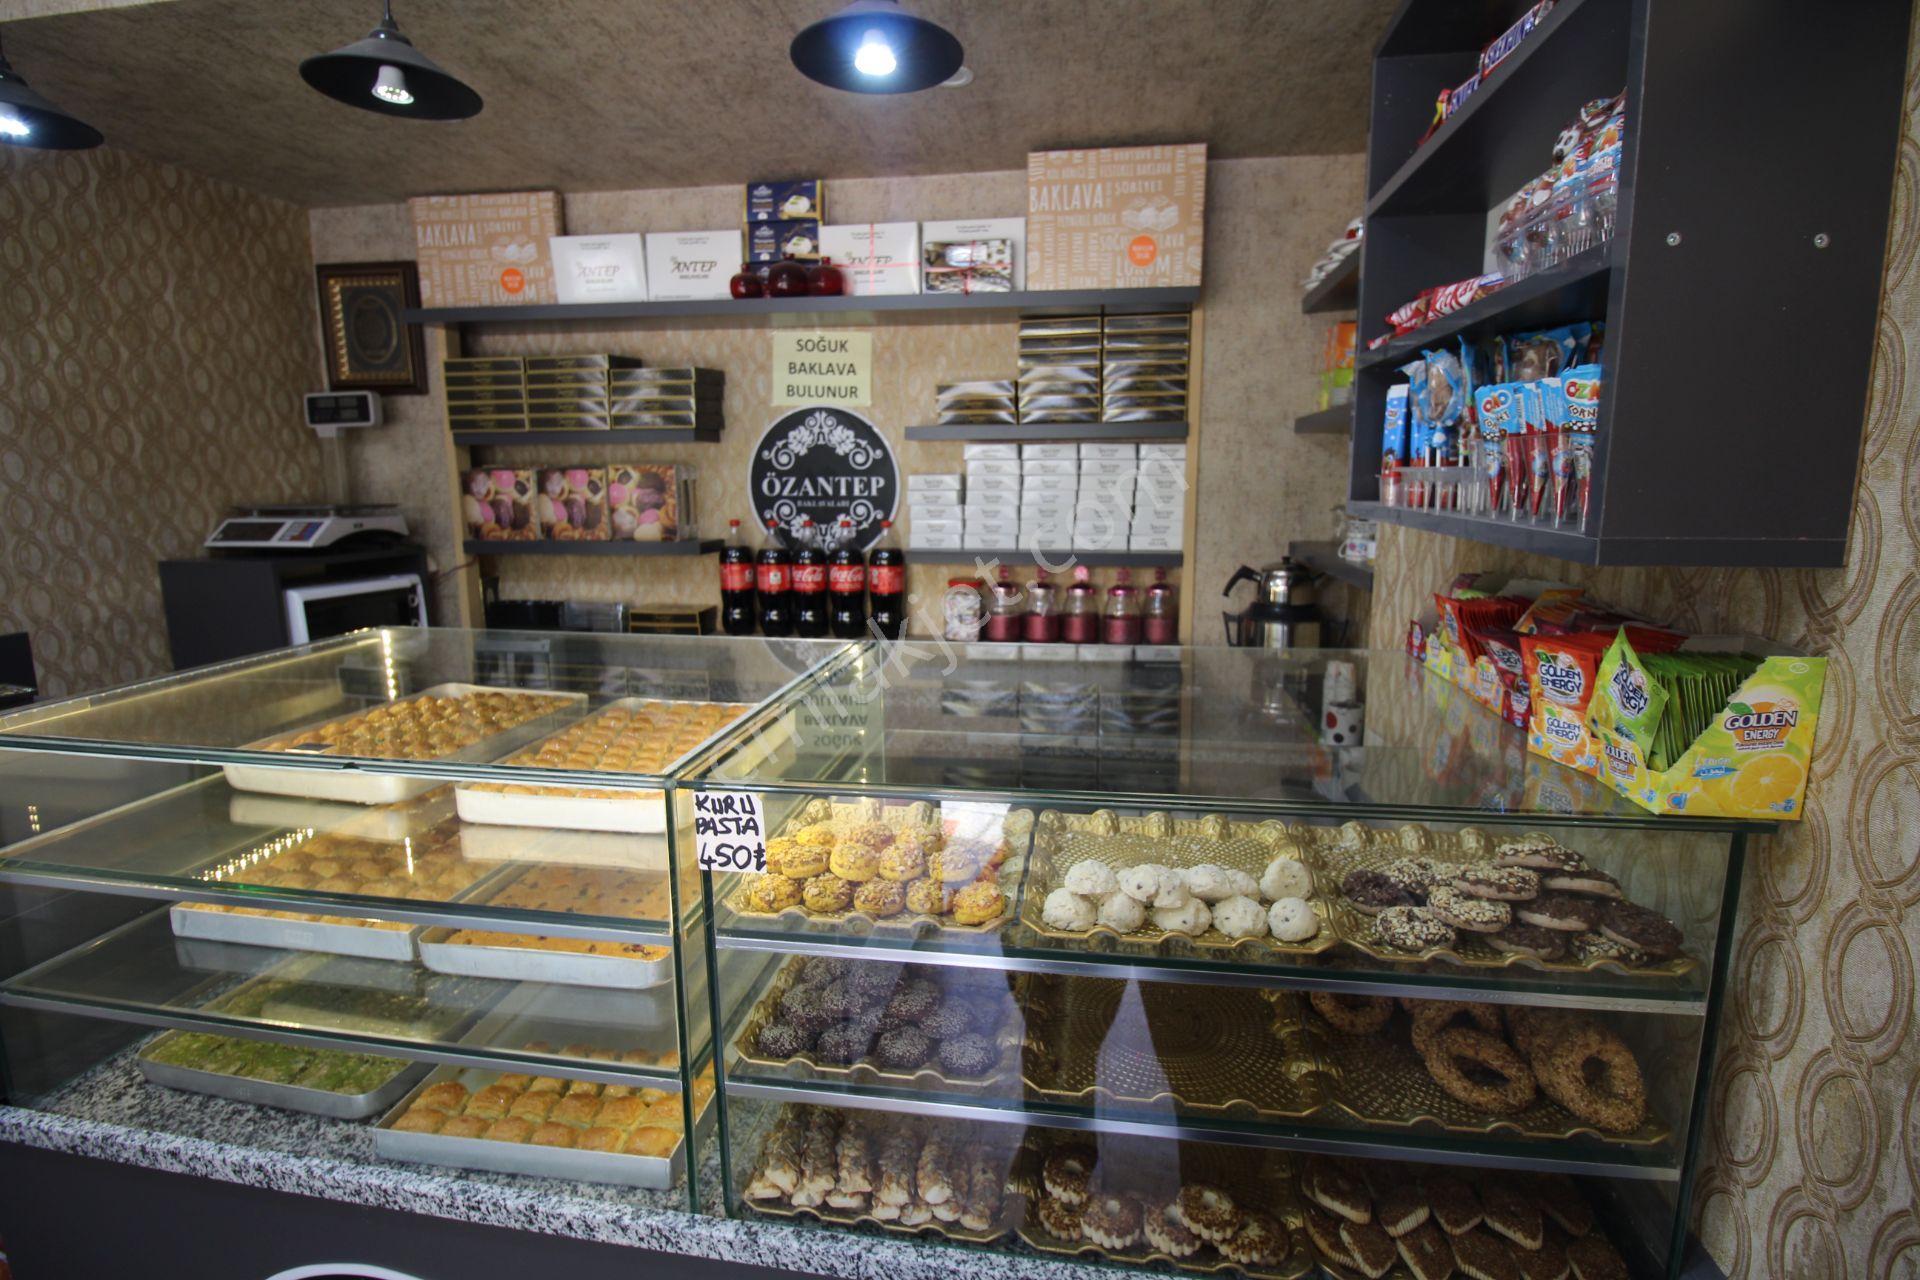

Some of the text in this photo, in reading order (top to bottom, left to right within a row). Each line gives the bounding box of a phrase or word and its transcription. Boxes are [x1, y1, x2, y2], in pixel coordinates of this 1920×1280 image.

[1029, 183, 1103, 213] BAKLAVA
[671, 261, 718, 274] ANTEP
[796, 336, 848, 353] SOĞUK
[788, 361, 857, 376] BAKLAVA
[786, 384, 858, 399] BULUNUR
[761, 472, 885, 497] ÖZANTEP
[1540, 663, 1582, 681] GOLDEN
[1541, 676, 1582, 693] ENERGY
[1546, 716, 1581, 733] GOLDEN
[1724, 710, 1799, 731] GOLDEN
[1546, 726, 1580, 742] ENERGY
[1744, 728, 1780, 741] ENERGY
[695, 794, 756, 815] KURU
[695, 816, 759, 836] PASTA
